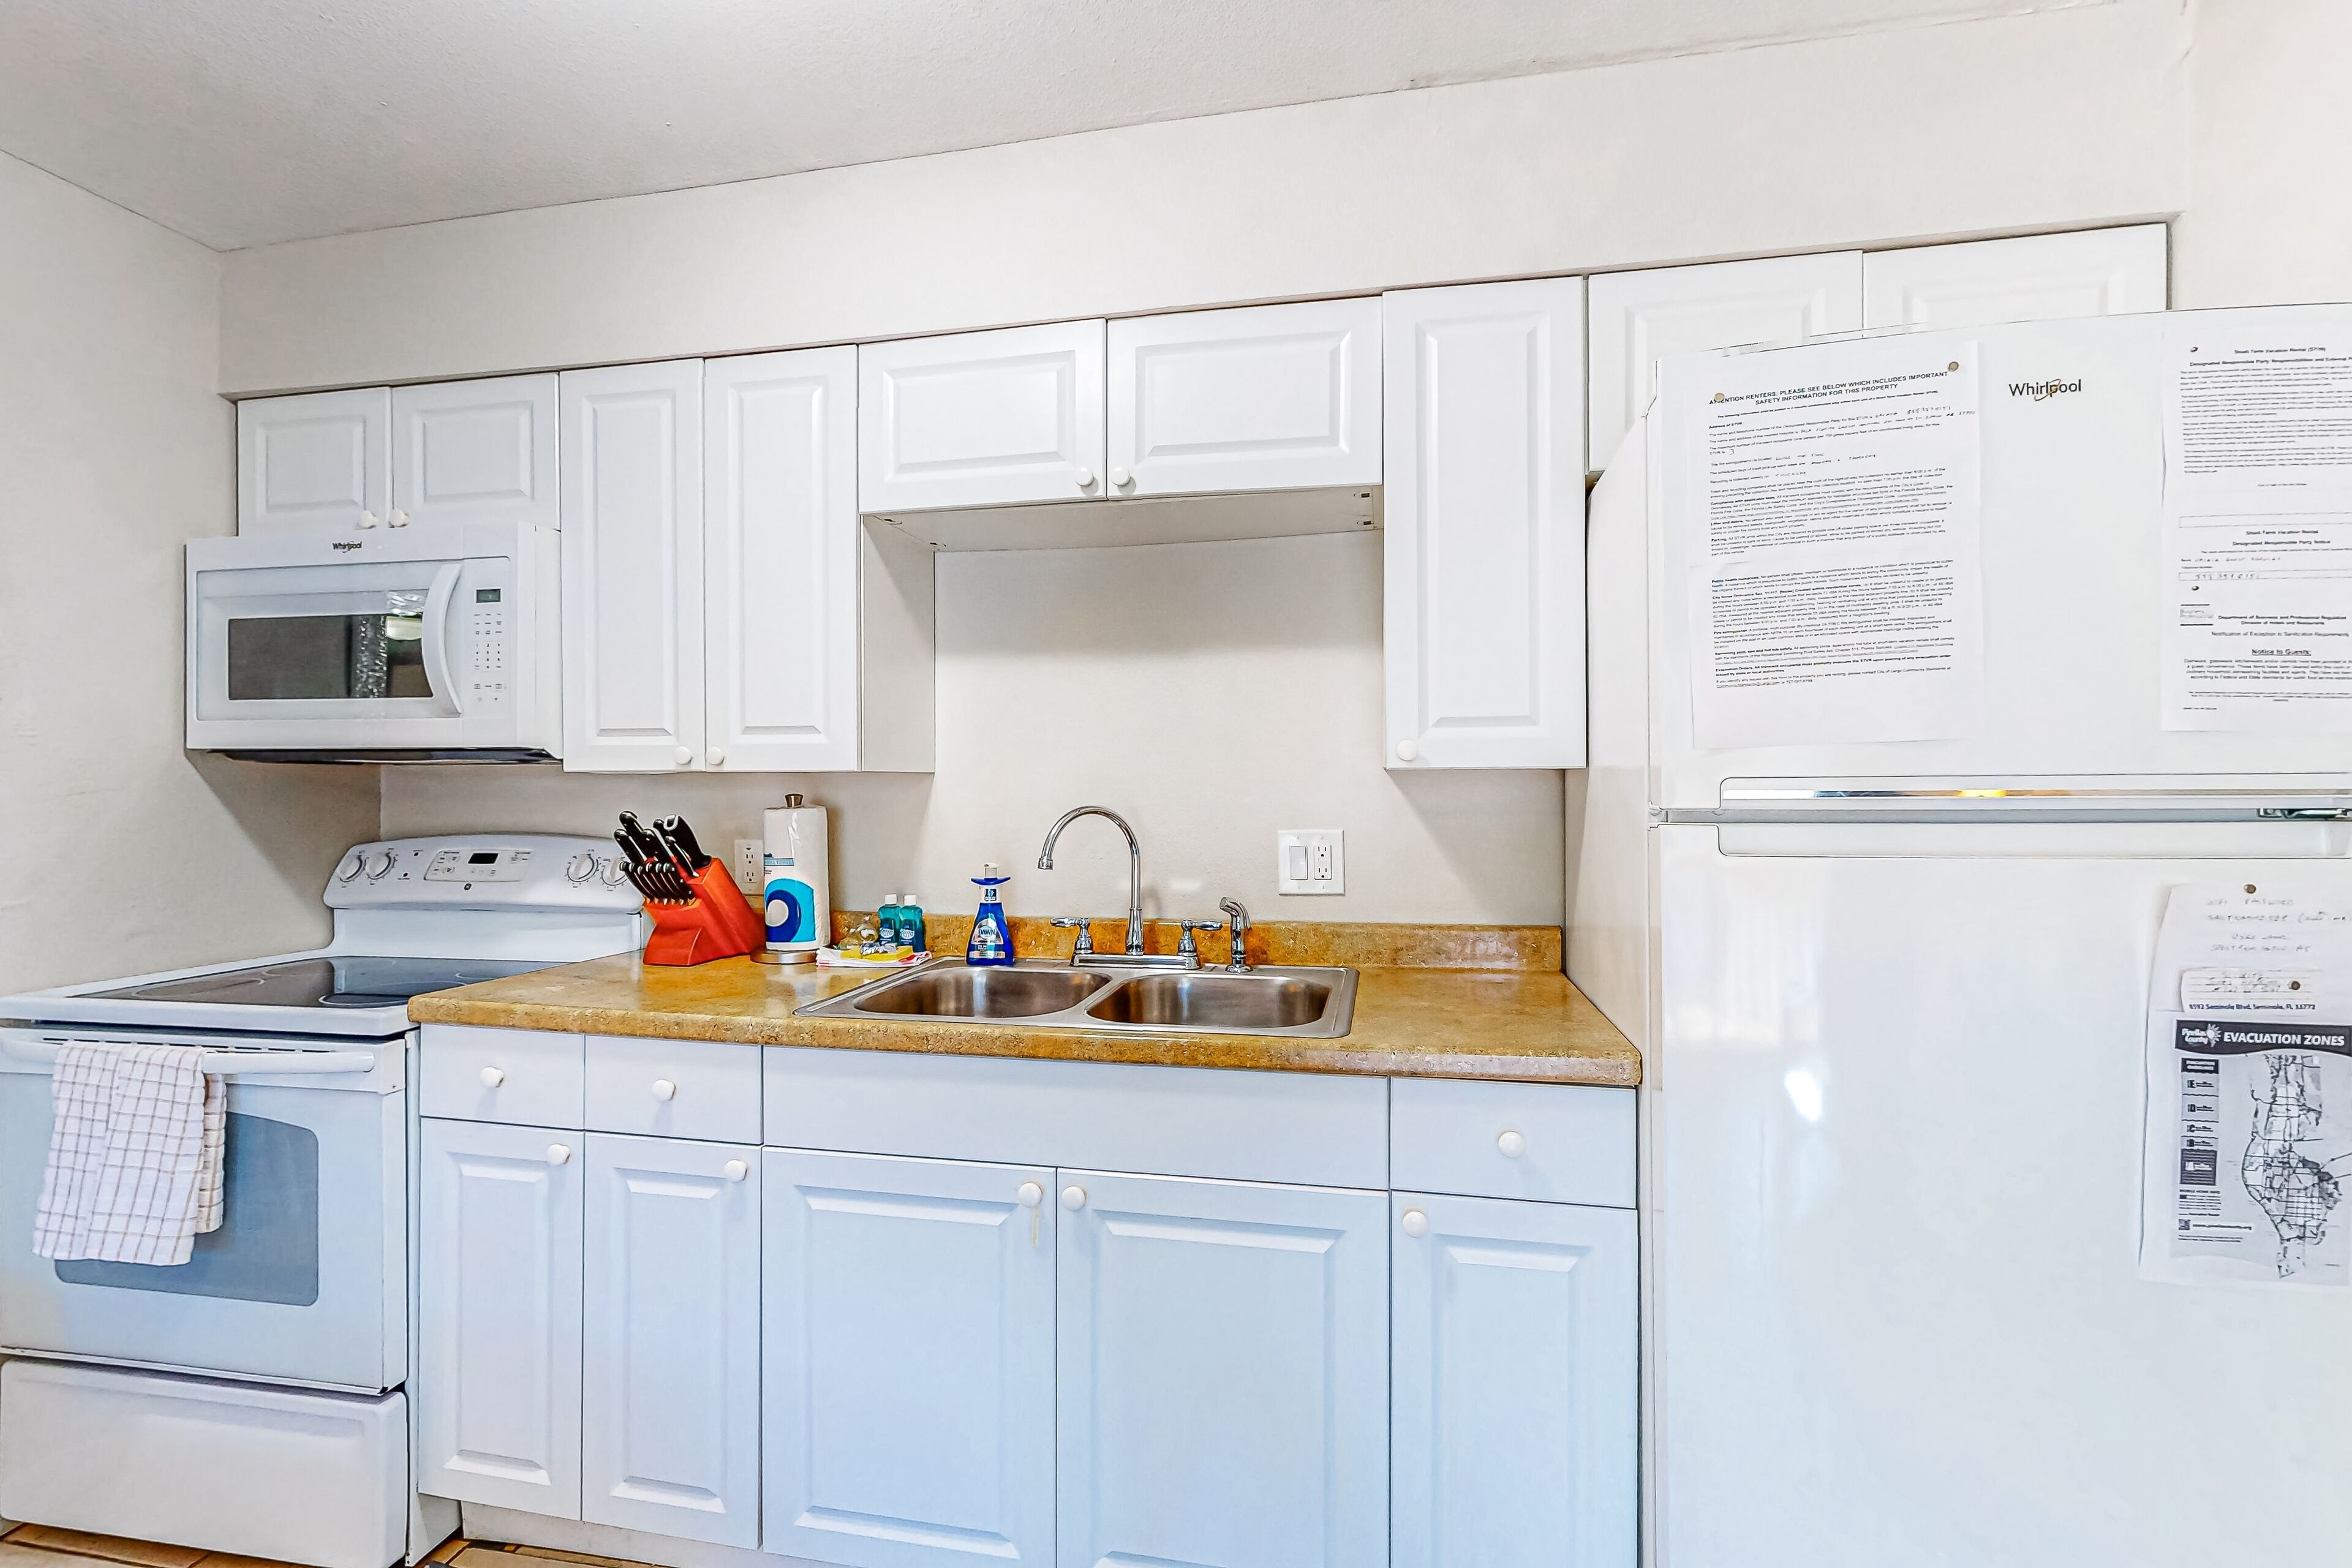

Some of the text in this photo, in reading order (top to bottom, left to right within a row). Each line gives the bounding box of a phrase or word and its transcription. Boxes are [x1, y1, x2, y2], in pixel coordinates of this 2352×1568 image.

[1709, 396, 1744, 404] ATENTION
[1872, 376, 1907, 385] INCLUDES
[1909, 371, 1948, 380] IMPORTANT
[1782, 392, 1827, 402] INFORMATION
[1861, 383, 1898, 392] PROPERTY
[2008, 379, 2082, 398] Whirlpool
[2223, 1031, 2345, 1046] EVACUATION ZONES
